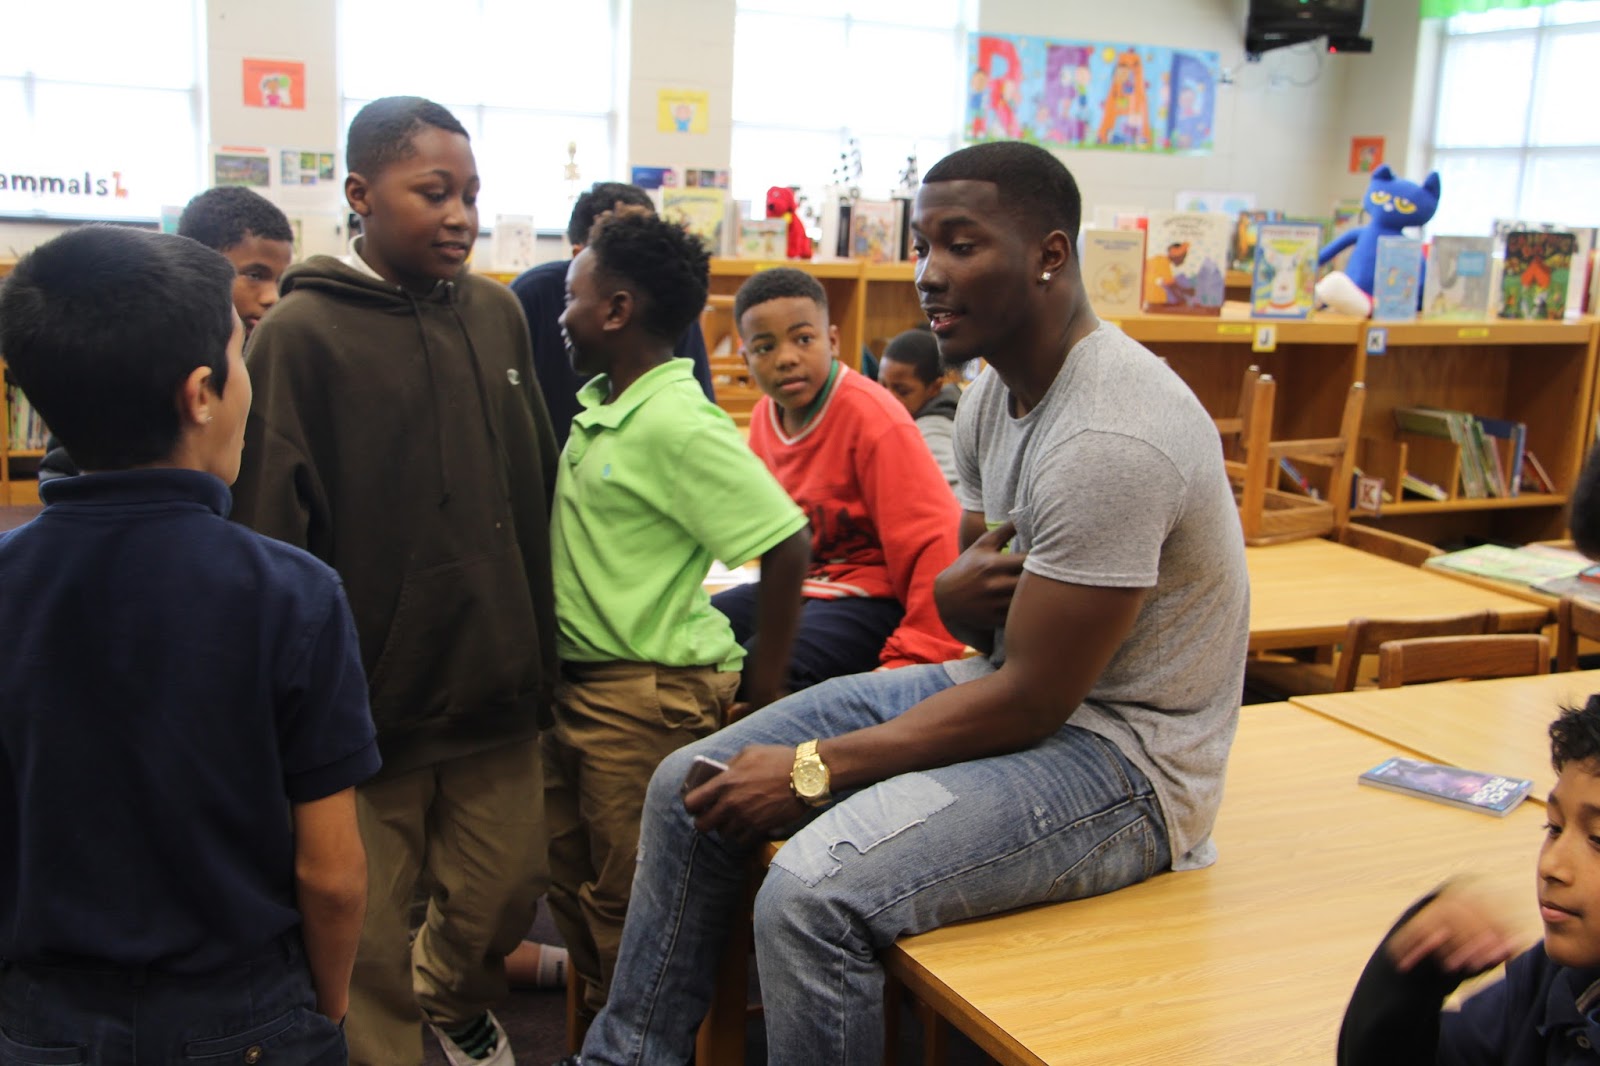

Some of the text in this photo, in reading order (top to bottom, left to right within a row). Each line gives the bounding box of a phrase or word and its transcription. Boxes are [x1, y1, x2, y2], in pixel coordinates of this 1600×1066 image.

[974, 36, 1217, 149] READ
[1260, 330, 1270, 345] J
[1370, 335, 1380, 348] K
